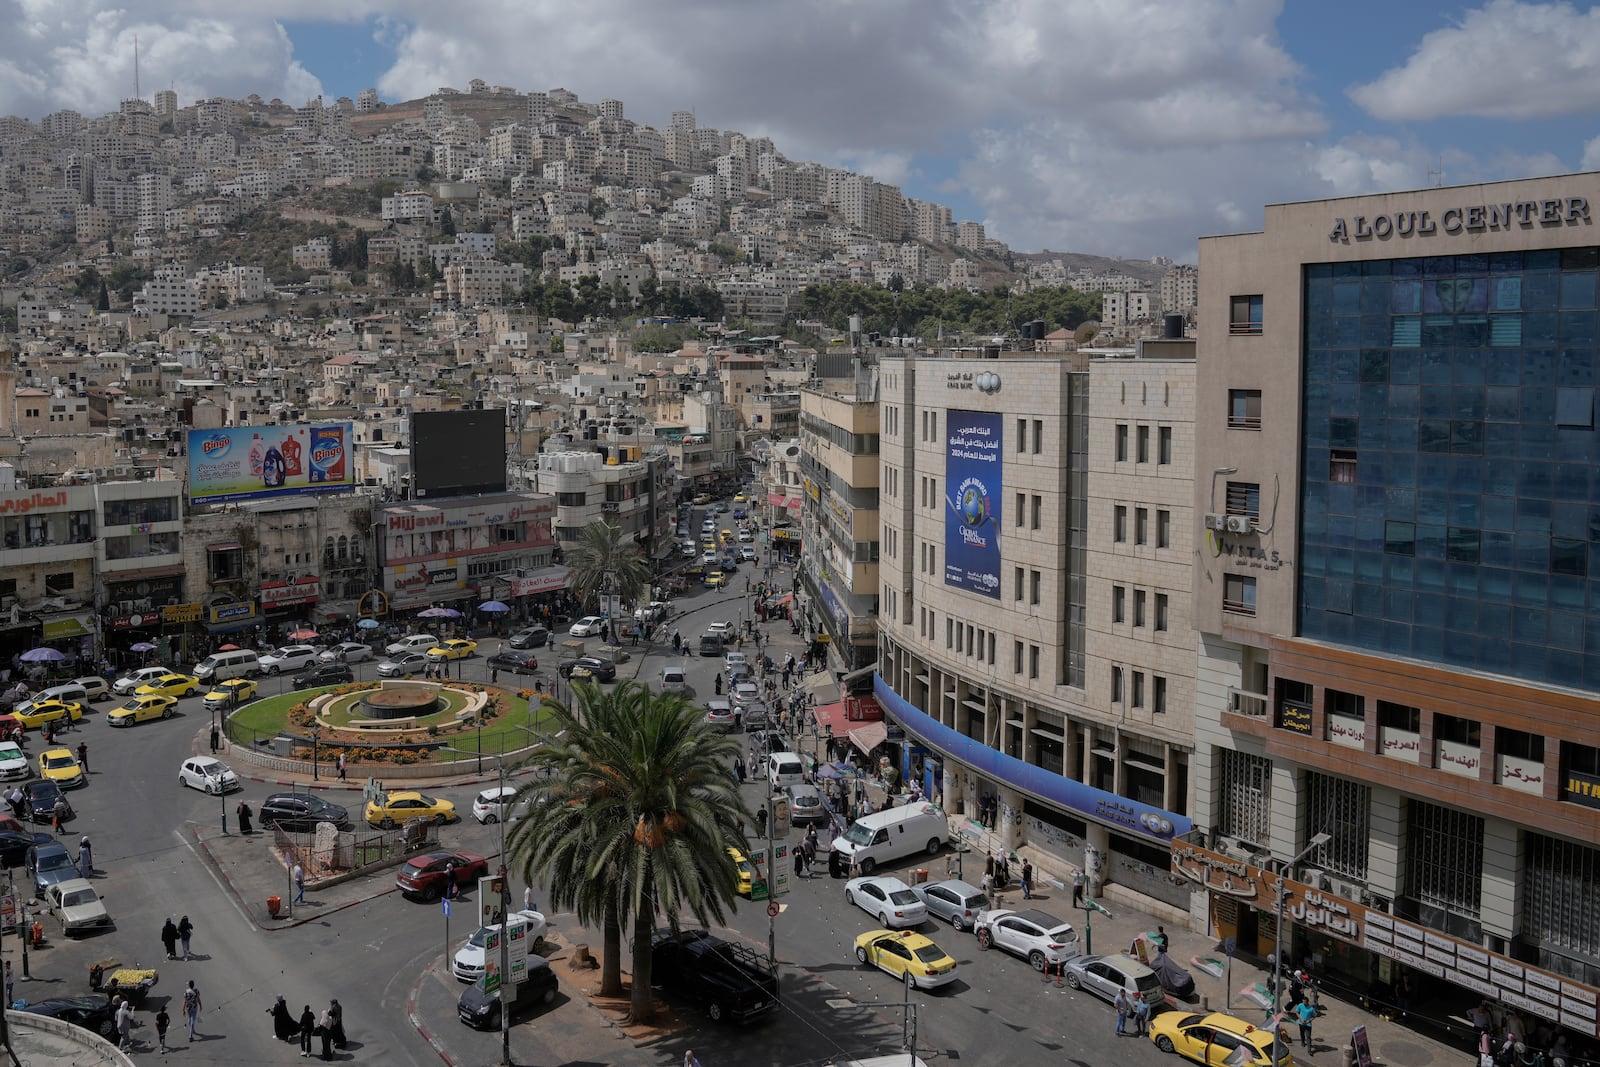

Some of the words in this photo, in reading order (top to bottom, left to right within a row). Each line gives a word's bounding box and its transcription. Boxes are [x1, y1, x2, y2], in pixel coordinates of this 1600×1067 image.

[1441, 197, 1590, 232] CENTER
[202, 438, 230, 453] Bingo
[314, 446, 342, 462] Bingo
[389, 512, 444, 531] Hijjawi
[1284, 707, 1310, 719] مركز
[1384, 739, 1419, 751] العربي
[1440, 748, 1479, 769] الهندسة
[1502, 765, 1542, 783] مركز
[1304, 889, 1348, 914] صيدلية
[1291, 901, 1357, 936] العالول
